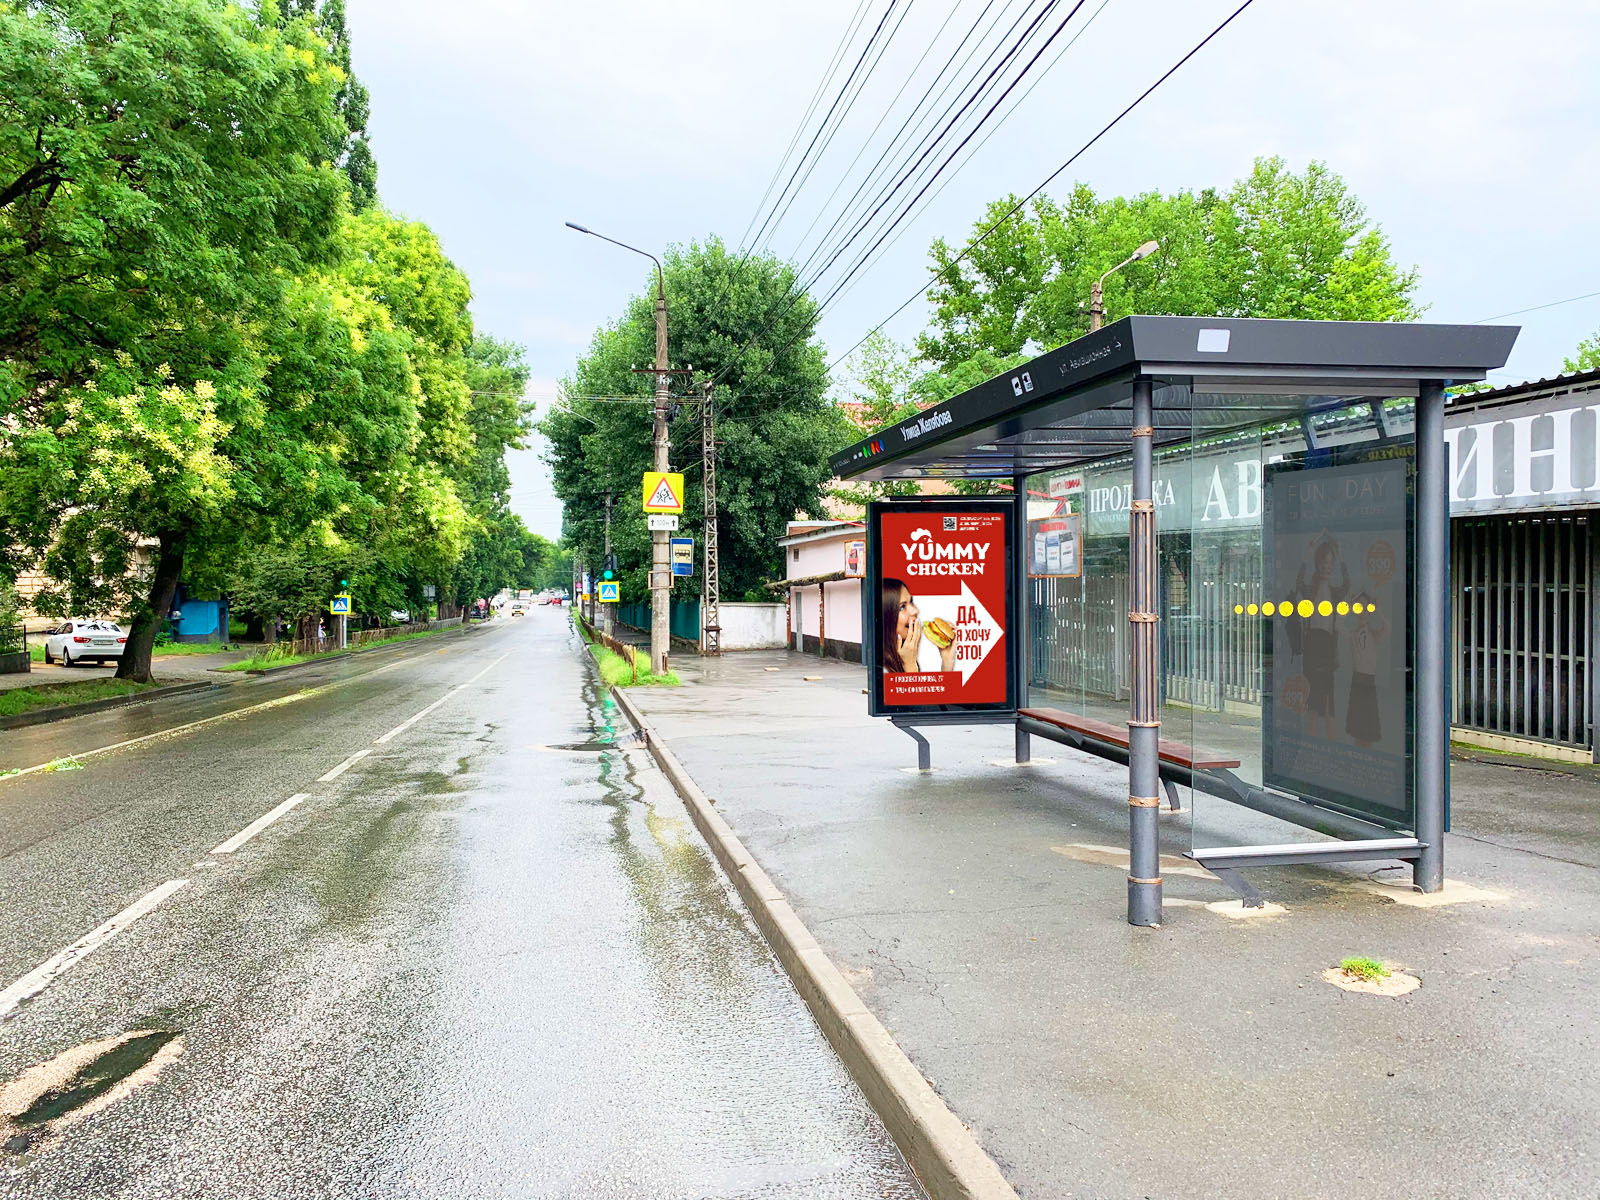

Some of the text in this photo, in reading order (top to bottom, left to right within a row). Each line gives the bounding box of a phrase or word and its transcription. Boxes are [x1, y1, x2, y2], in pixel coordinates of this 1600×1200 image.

[900, 410, 953, 442] Улица Желябова
[1288, 476, 1386, 504] FUN DAY
[901, 541, 990, 561] YUMMY
[906, 562, 985, 576] CHICKEN
[956, 605, 981, 627] ДА,
[956, 628, 990, 642] Я ХОЧУ
[956, 644, 982, 660] ЭТО!
